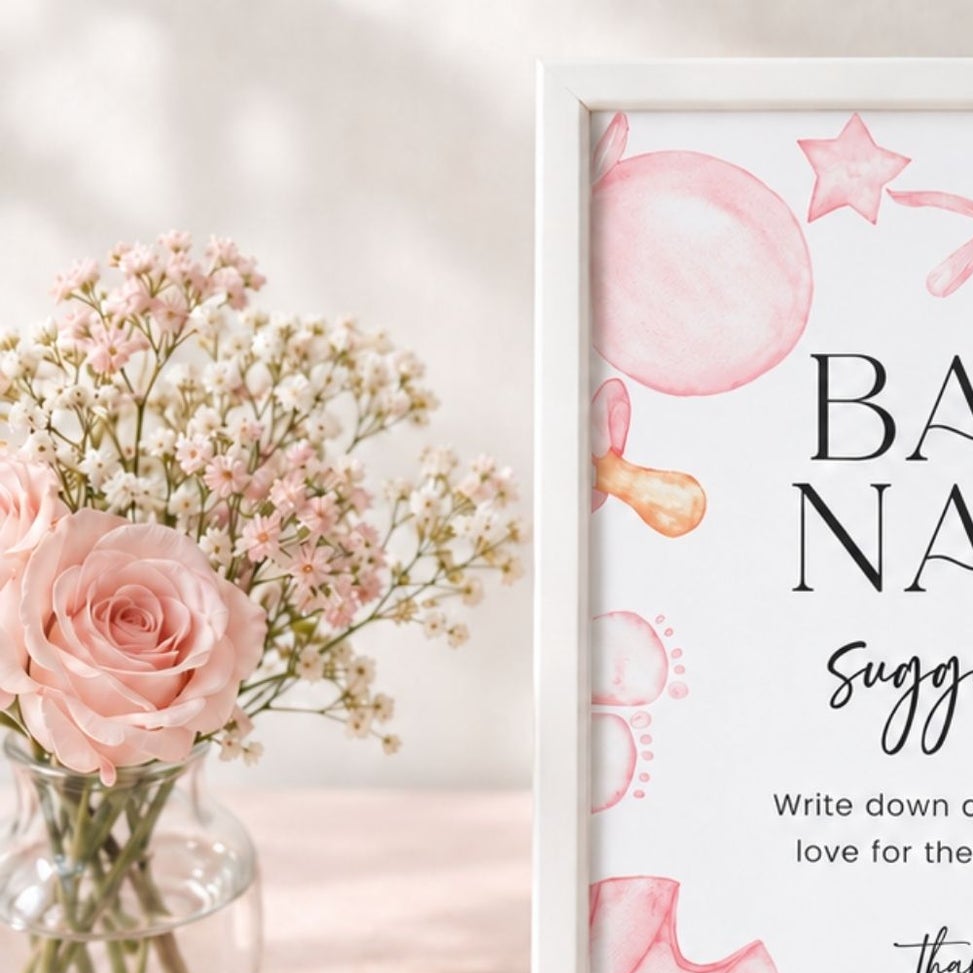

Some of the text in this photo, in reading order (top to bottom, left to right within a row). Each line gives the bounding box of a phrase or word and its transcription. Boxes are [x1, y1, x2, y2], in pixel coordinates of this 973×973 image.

[773, 792, 853, 816] Write
[865, 792, 948, 816] down
[796, 838, 858, 863] love
[871, 838, 912, 863] for
[924, 840, 972, 863] the
